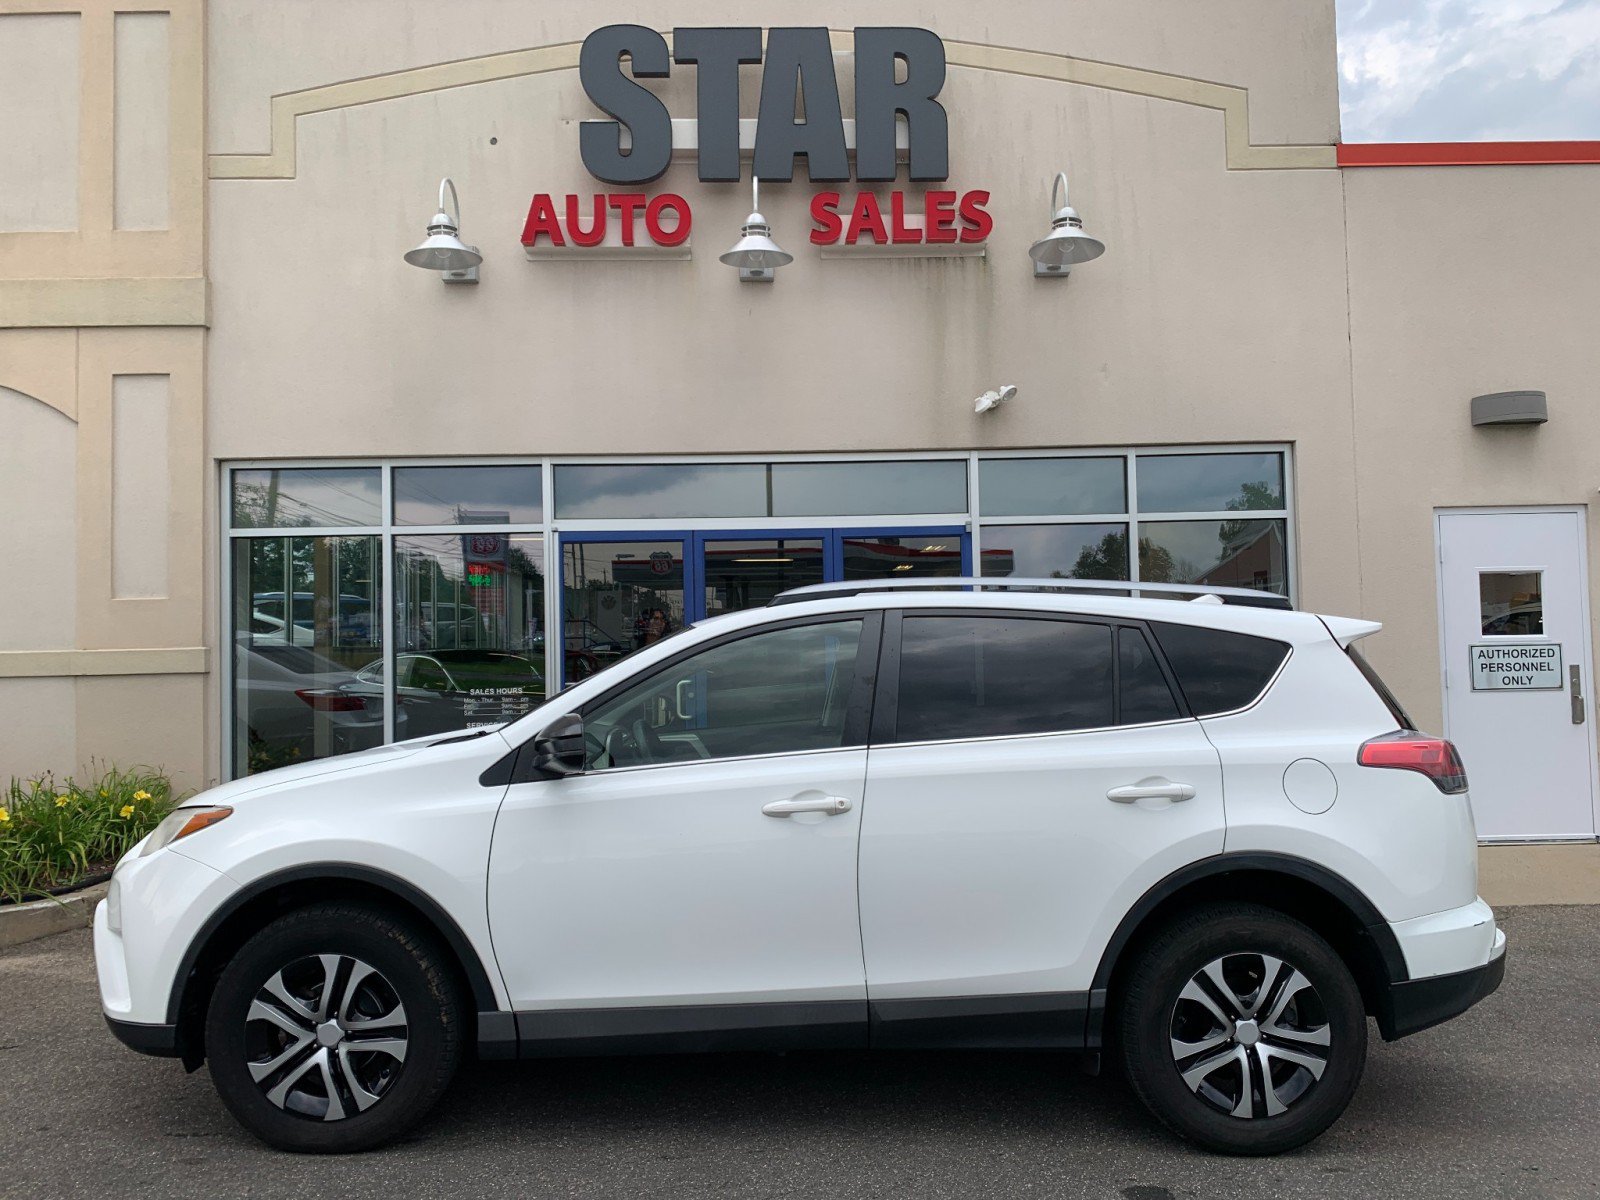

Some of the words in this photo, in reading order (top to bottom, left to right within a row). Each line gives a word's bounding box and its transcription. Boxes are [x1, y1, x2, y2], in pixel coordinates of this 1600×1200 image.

[579, 24, 949, 186] STAR
[521, 193, 692, 247] AUTO
[809, 190, 993, 245] SALES
[1478, 648, 1555, 659] AUTHORIZED
[1480, 661, 1554, 672] PERSONNEL
[1502, 675, 1534, 685] ONLY
